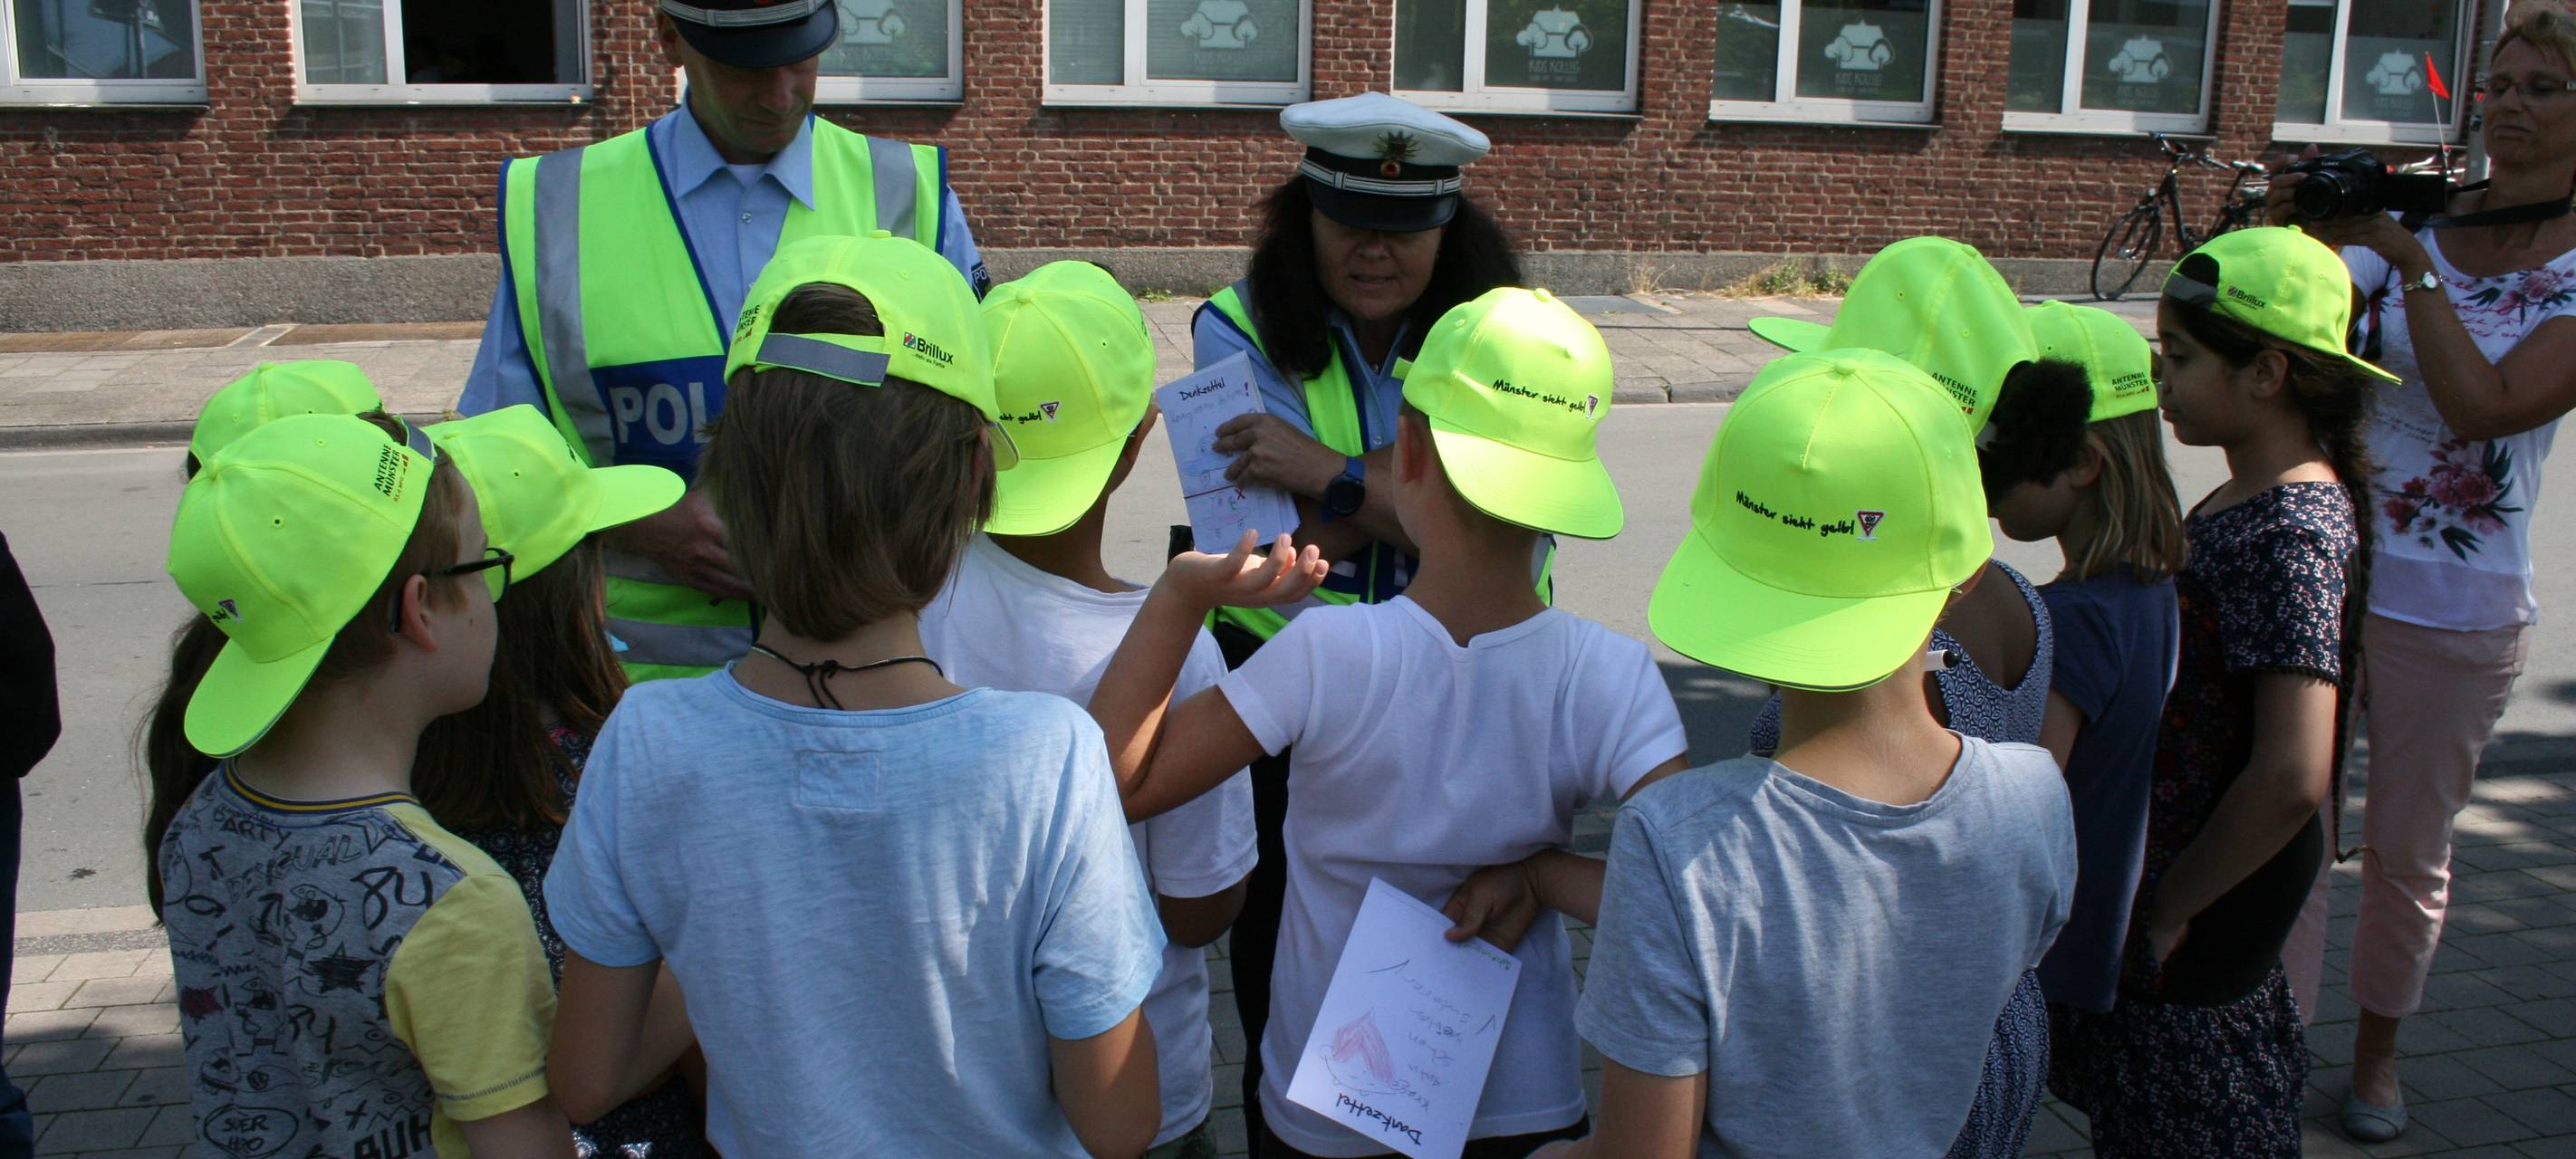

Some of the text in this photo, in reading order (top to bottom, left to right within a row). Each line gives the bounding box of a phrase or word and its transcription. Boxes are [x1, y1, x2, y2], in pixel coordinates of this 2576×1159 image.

[2236, 290, 2266, 309] Brillux
[917, 337, 955, 365] Brillux
[1179, 377, 1226, 401] Denkzettel
[1493, 378, 1539, 398] Münster
[1543, 394, 1568, 406] sieht
[1931, 372, 1978, 399] ANTENNE
[374, 443, 391, 492] ANTENNE
[382, 449, 400, 497] MÜNSTER
[1735, 490, 1777, 520] Münster
[1782, 513, 1815, 530] sieht
[1336, 1093, 1423, 1145] Dankzettel
